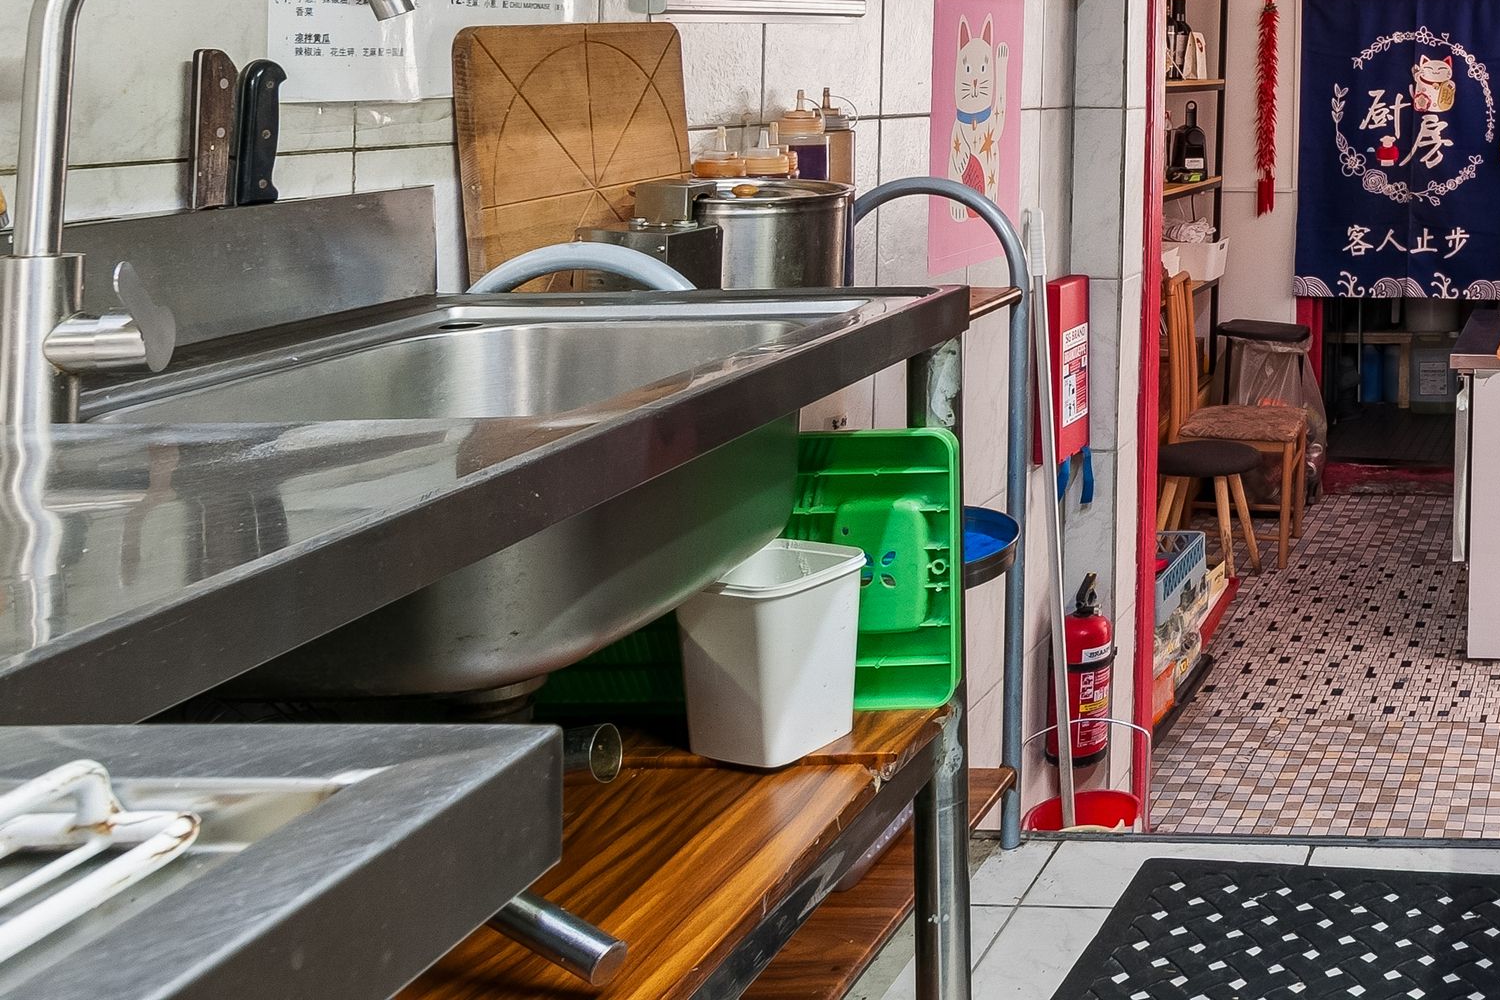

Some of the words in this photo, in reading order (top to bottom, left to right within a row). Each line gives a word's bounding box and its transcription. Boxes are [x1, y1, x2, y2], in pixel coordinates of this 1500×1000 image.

[296, 7, 314, 17] 香菜
[294, 32, 331, 45] 凉拌黄瓜
[1359, 88, 1454, 169] 厨房
[1342, 223, 1471, 260] 客人止步
